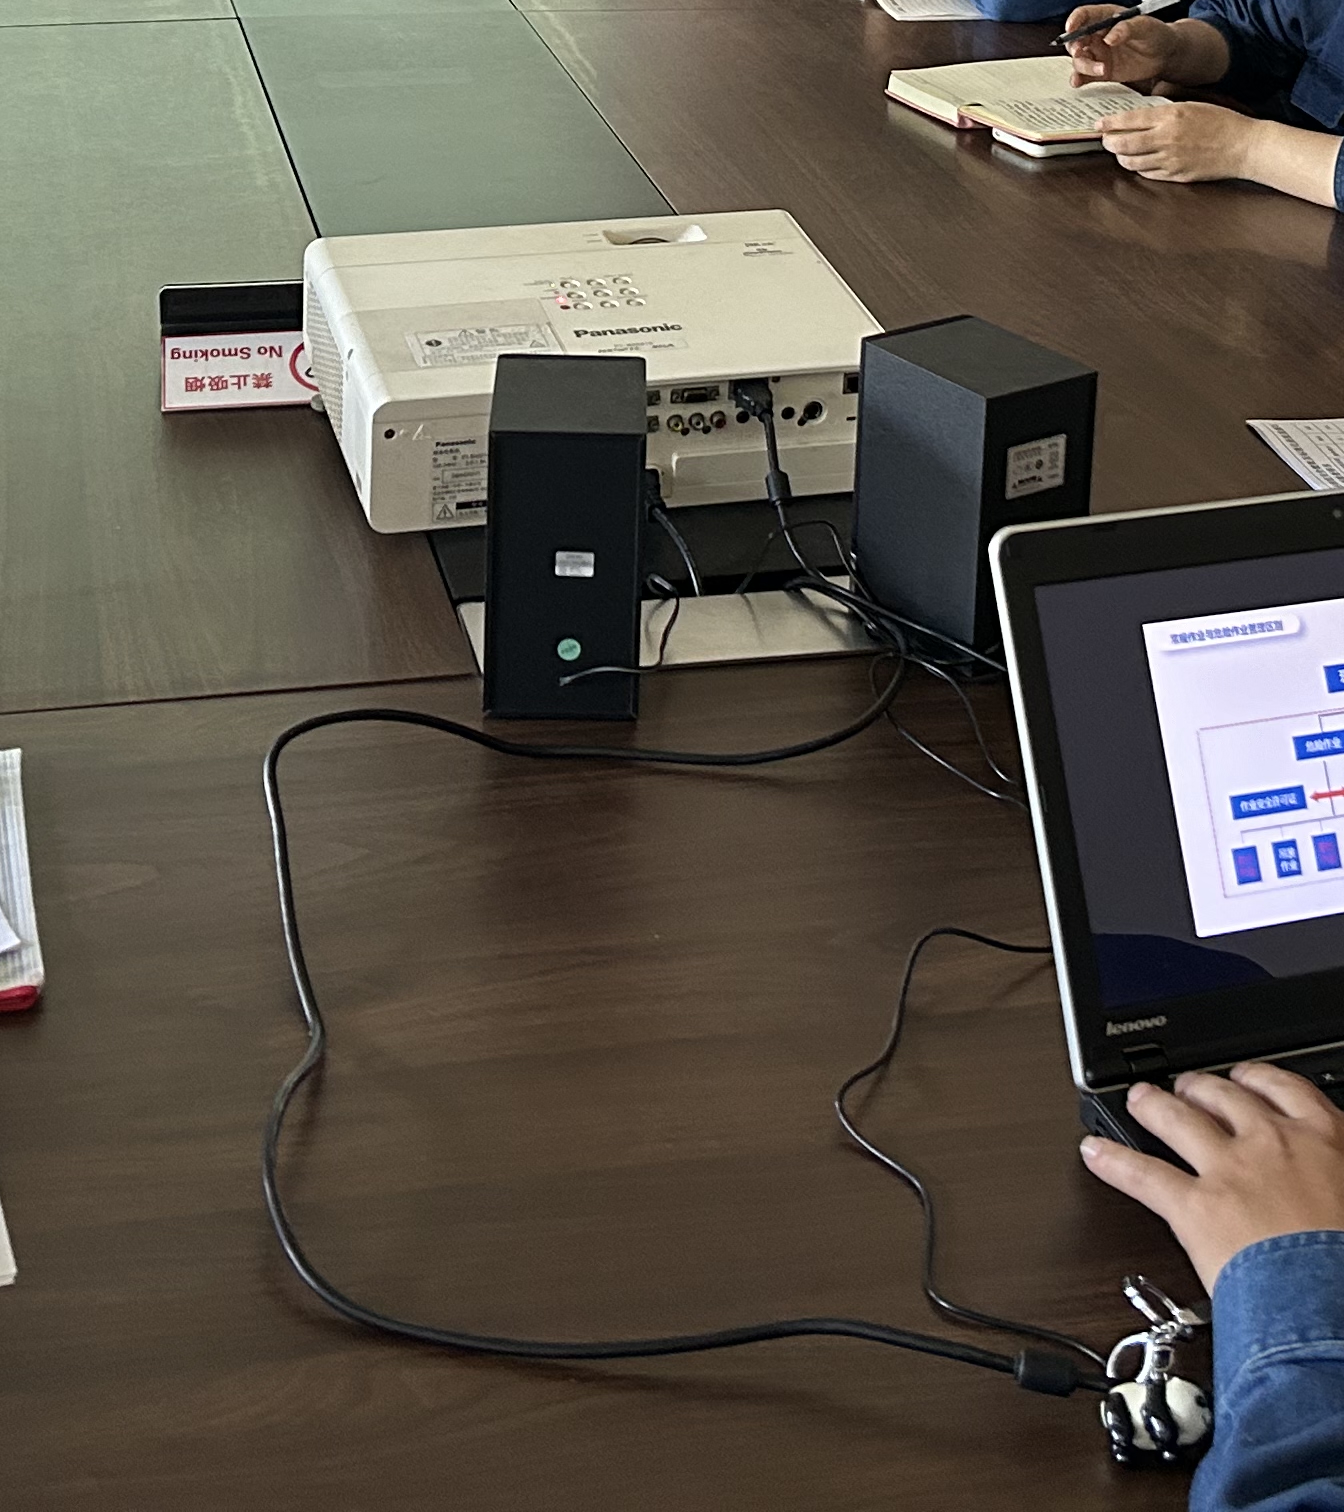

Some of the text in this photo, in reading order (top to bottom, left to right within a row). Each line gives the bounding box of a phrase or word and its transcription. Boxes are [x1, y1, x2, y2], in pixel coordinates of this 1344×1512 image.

[573, 322, 683, 339] Panasonic
[171, 345, 283, 363] No Smoking
[185, 372, 274, 393] 禁止吸烟
[1105, 1015, 1168, 1037] lenovo
